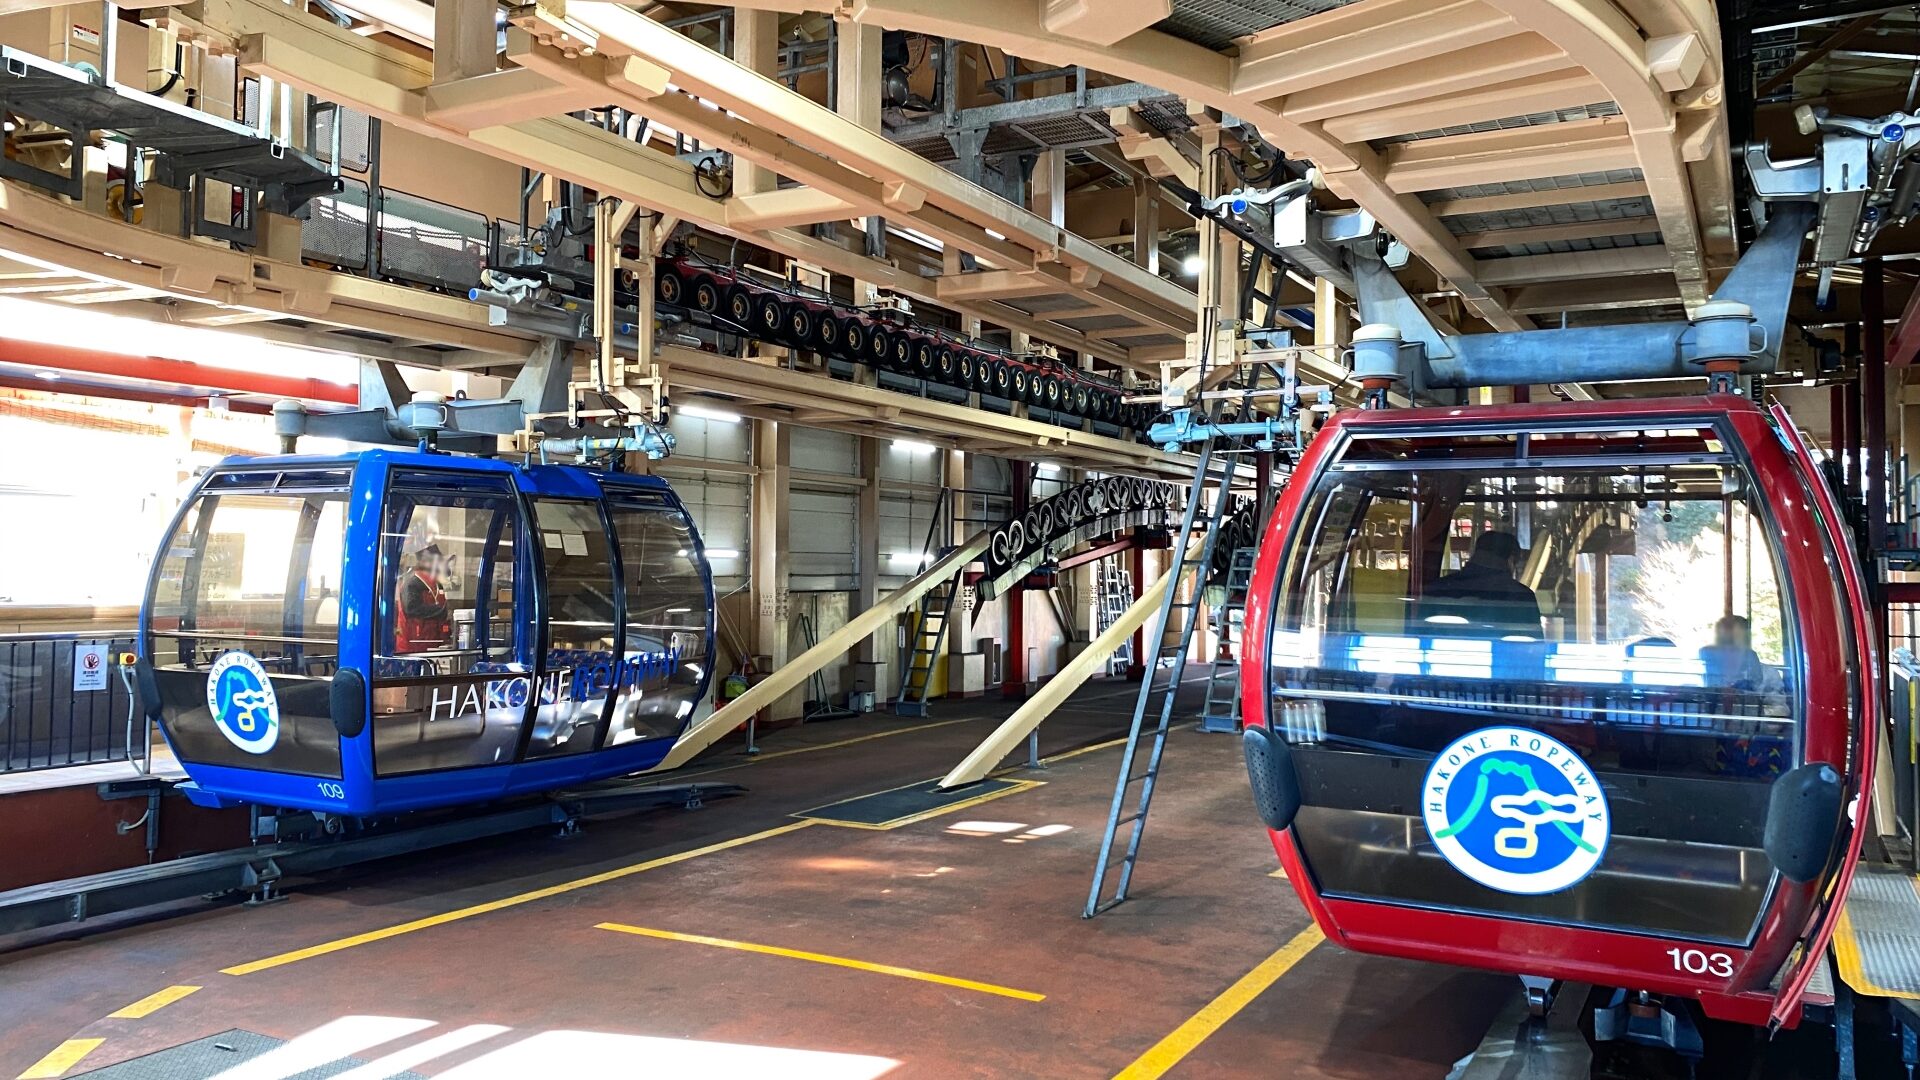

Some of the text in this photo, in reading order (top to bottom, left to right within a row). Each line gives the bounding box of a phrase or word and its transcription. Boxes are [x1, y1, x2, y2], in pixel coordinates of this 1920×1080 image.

[429, 669, 572, 722] HAKONE
[317, 782, 345, 799] 109
[1429, 734, 1602, 822] HAKONE ROPEWAY
[1666, 947, 1734, 978] 103
